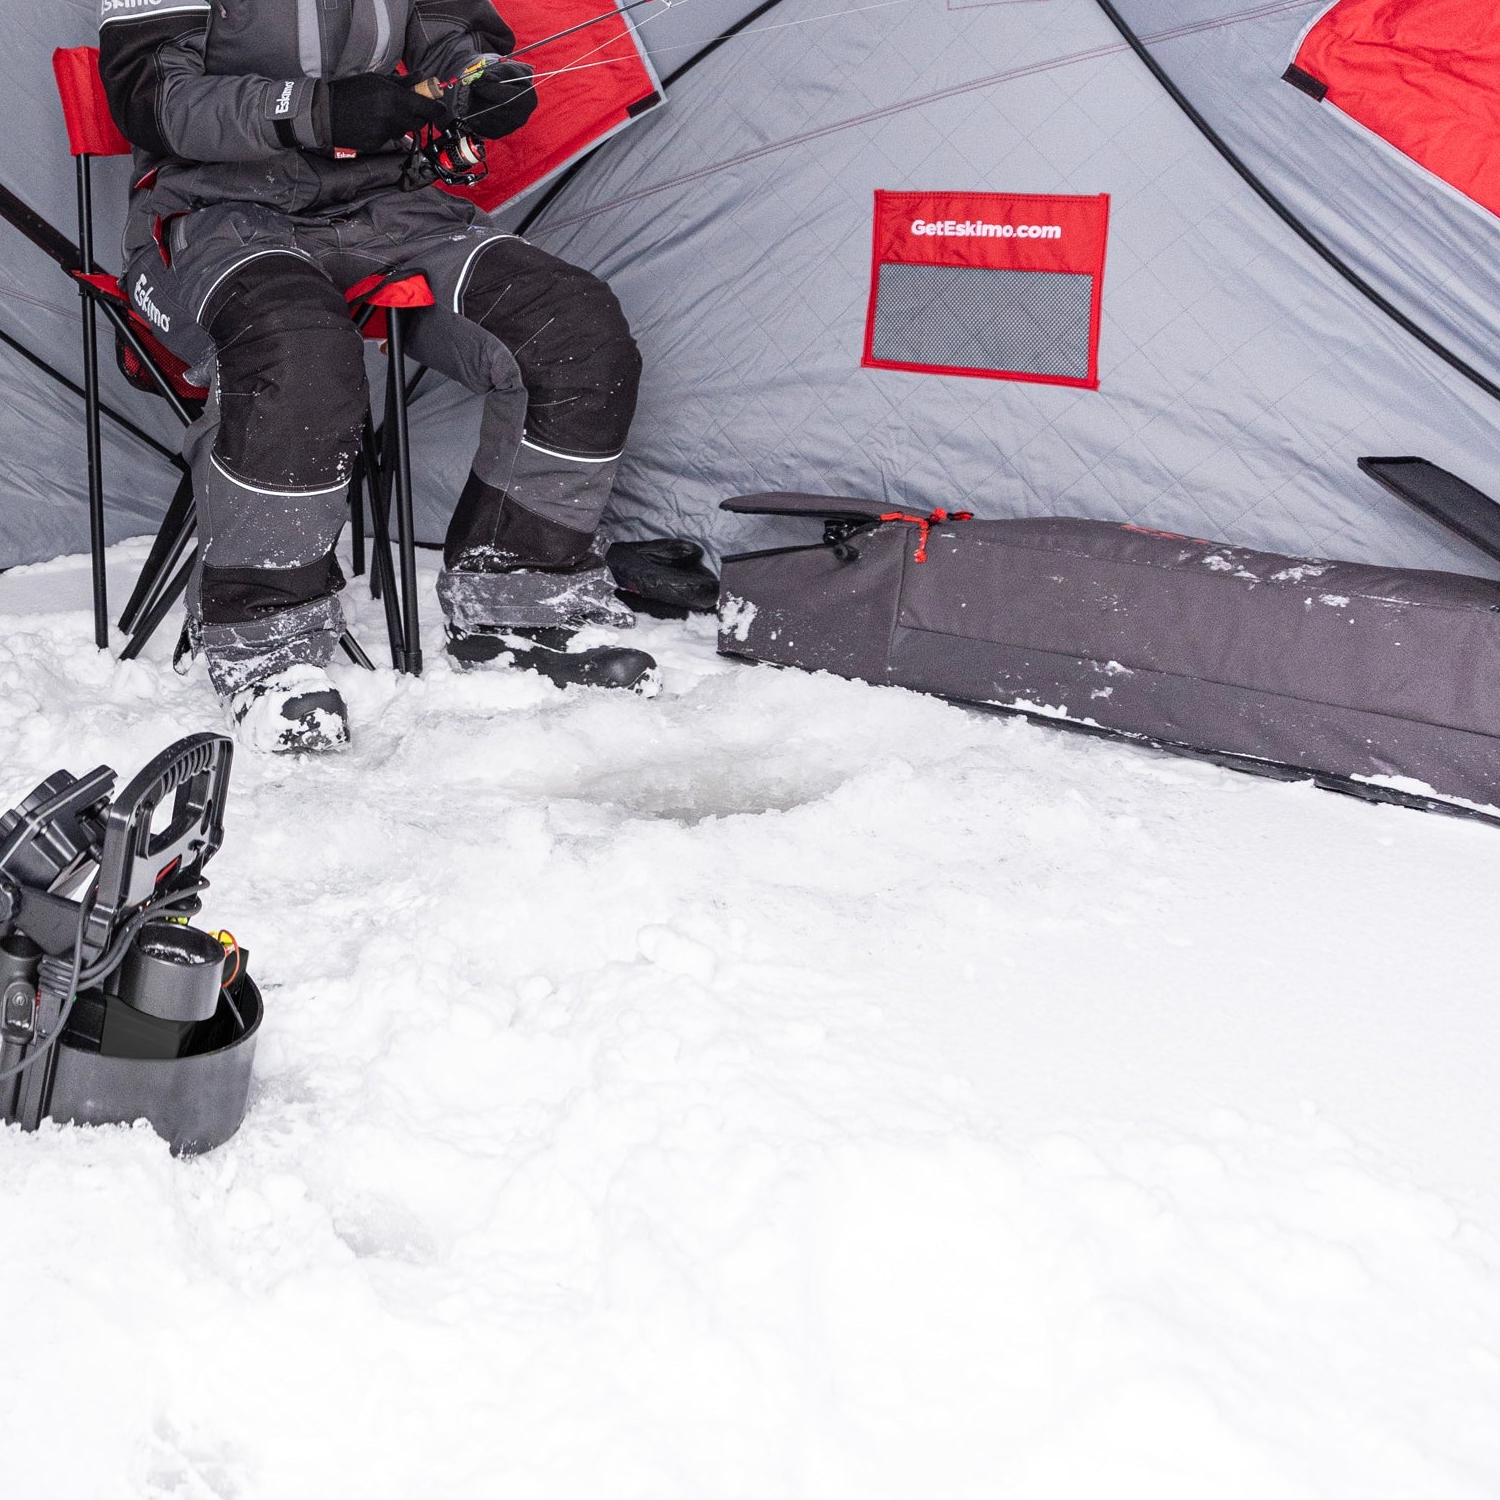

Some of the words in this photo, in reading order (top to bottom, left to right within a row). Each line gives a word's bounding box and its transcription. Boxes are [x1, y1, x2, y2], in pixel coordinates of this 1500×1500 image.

[275, 80, 295, 114] Eskimo
[911, 219, 1062, 239] GetEskimo.com
[134, 273, 170, 333] Eskimo
